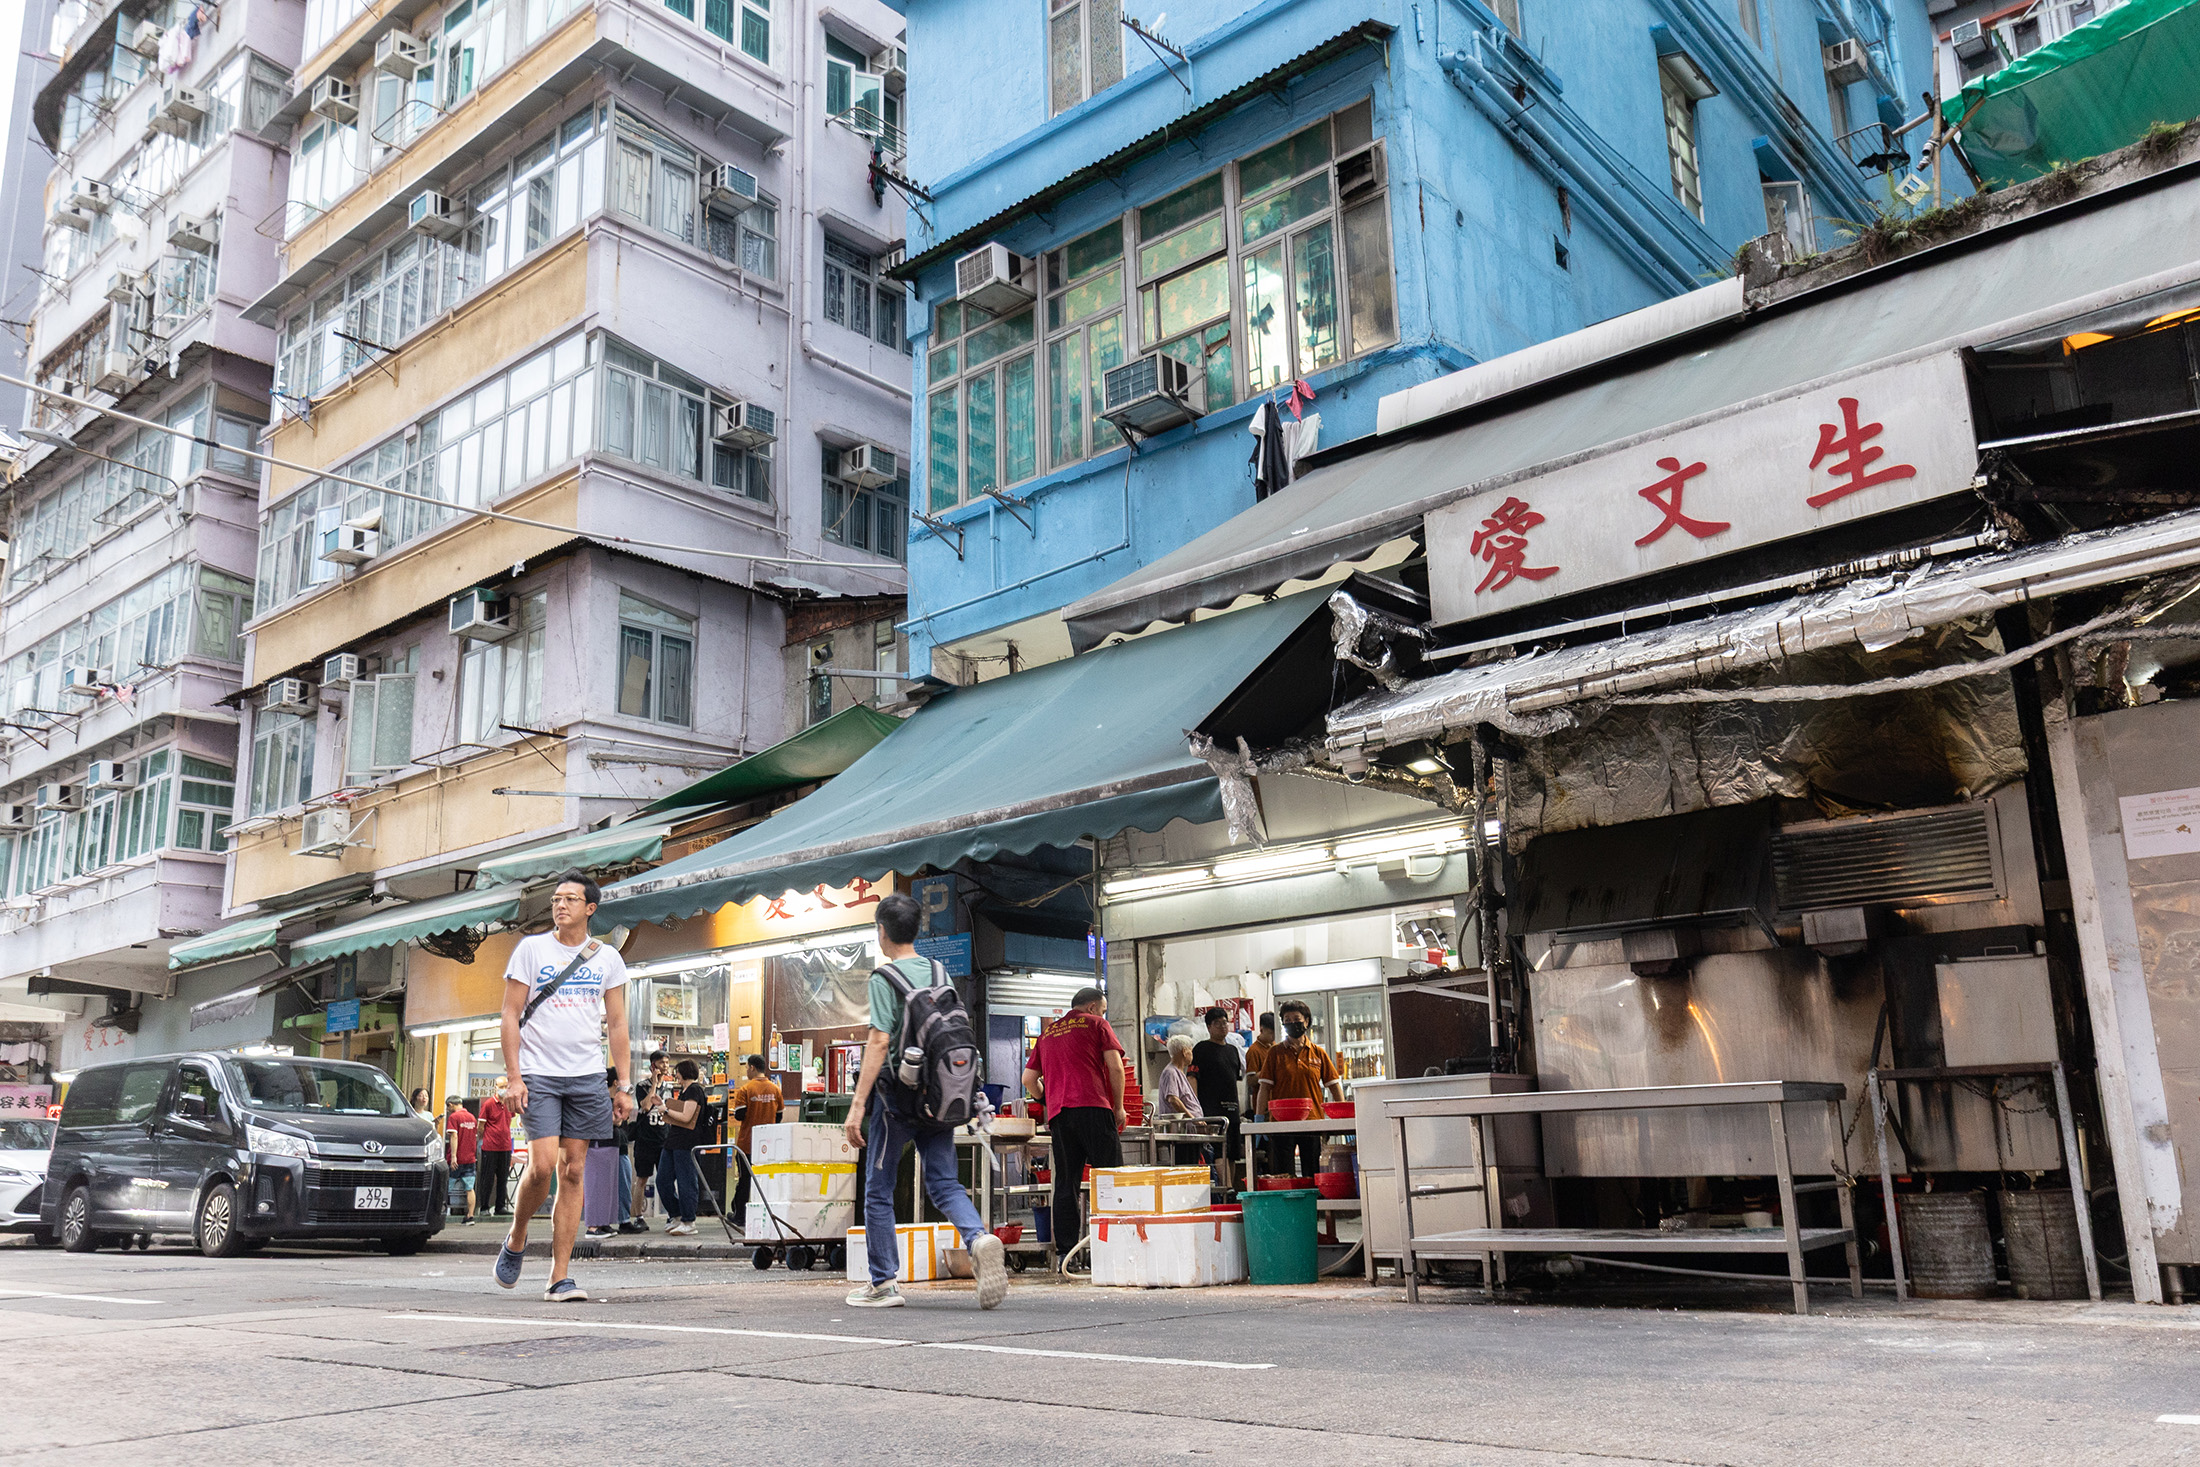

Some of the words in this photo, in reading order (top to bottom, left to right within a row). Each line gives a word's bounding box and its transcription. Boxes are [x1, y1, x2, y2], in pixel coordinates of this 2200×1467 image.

[1470, 397, 1917, 595] 愛文生
[922, 883, 949, 932] P
[341, 962, 353, 997] P
[357, 1197, 389, 1208] 2775
[366, 1188, 382, 1198] XD
